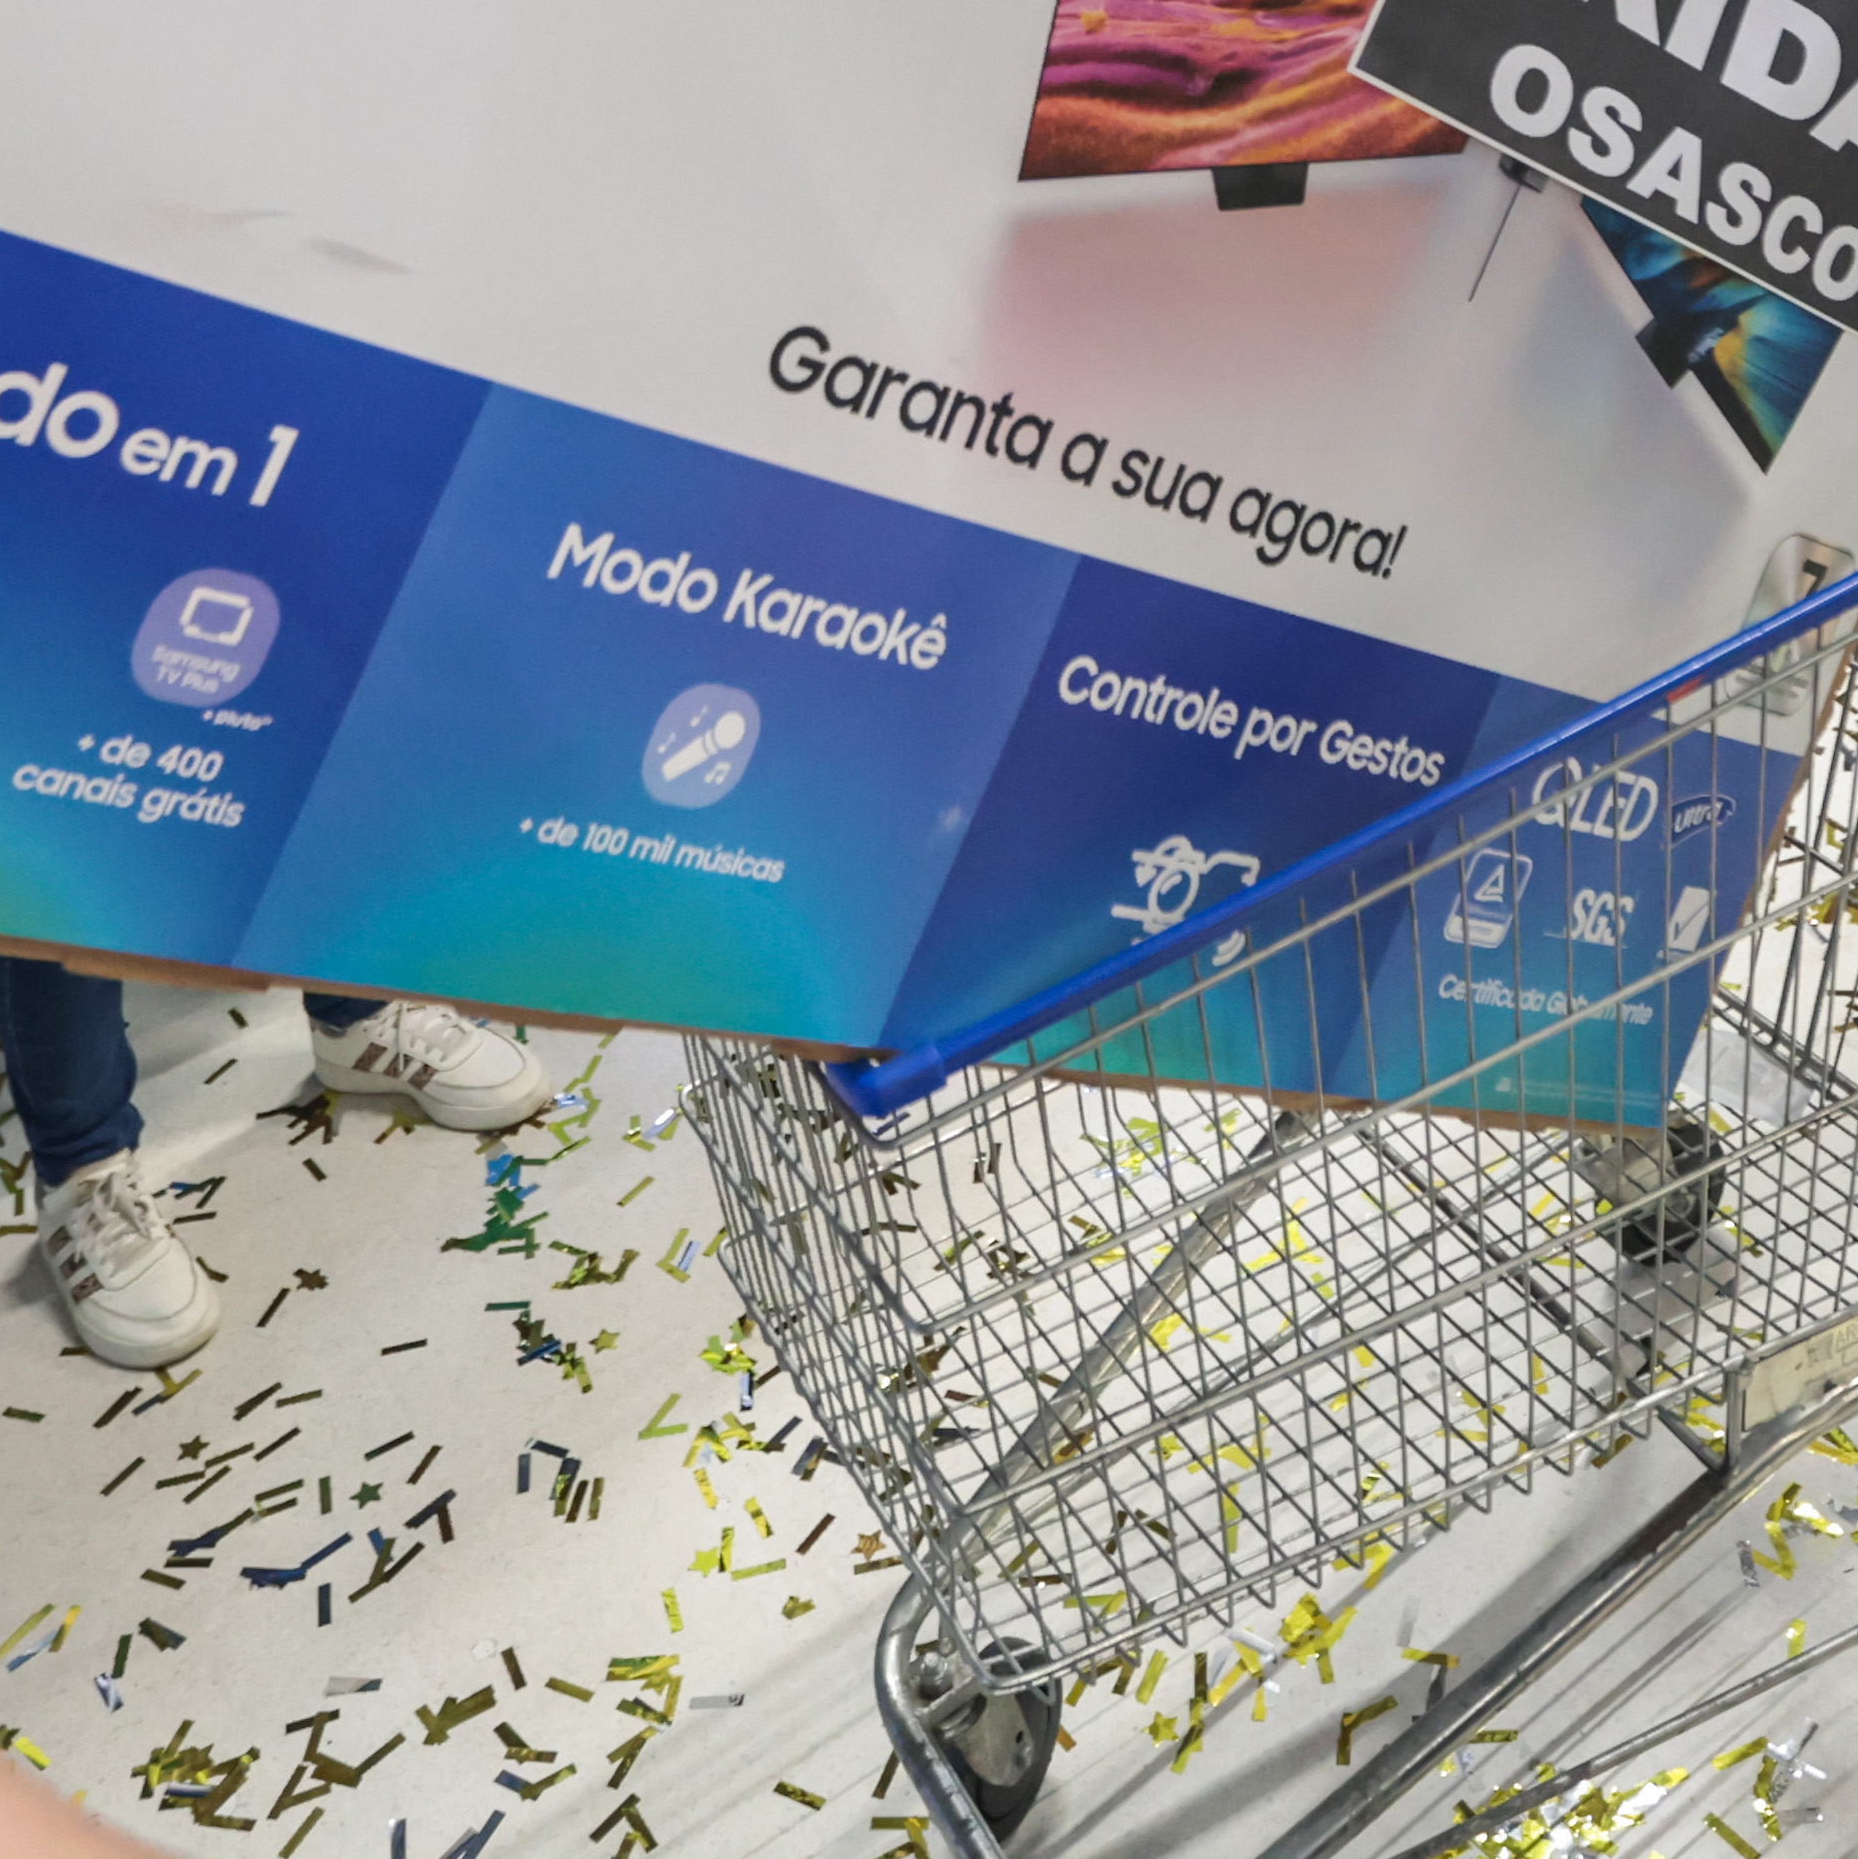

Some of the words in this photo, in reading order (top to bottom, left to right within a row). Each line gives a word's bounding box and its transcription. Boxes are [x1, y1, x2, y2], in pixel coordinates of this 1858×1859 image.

[120, 425, 238, 495] em
[249, 425, 300, 507] 1
[768, 323, 1055, 471] Garanta
[1059, 430, 1109, 486] a
[1111, 447, 1222, 524] sua
[1228, 487, 1409, 580] agora!
[547, 523, 719, 614] Modo
[724, 567, 949, 672] Karaokê
[99, 735, 149, 770] de
[155, 744, 224, 782] 400
[1058, 655, 1240, 743] Controle
[1233, 708, 1316, 759] por
[1317, 721, 1445, 788] Gestos
[12, 763, 137, 809] canais
[138, 781, 245, 828] grátis
[1532, 756, 1659, 842] QLED
[537, 814, 579, 849] de
[582, 822, 627, 858] 100
[628, 830, 675, 866] mil
[675, 838, 786, 884] músicas
[1569, 888, 1635, 947] SGS
